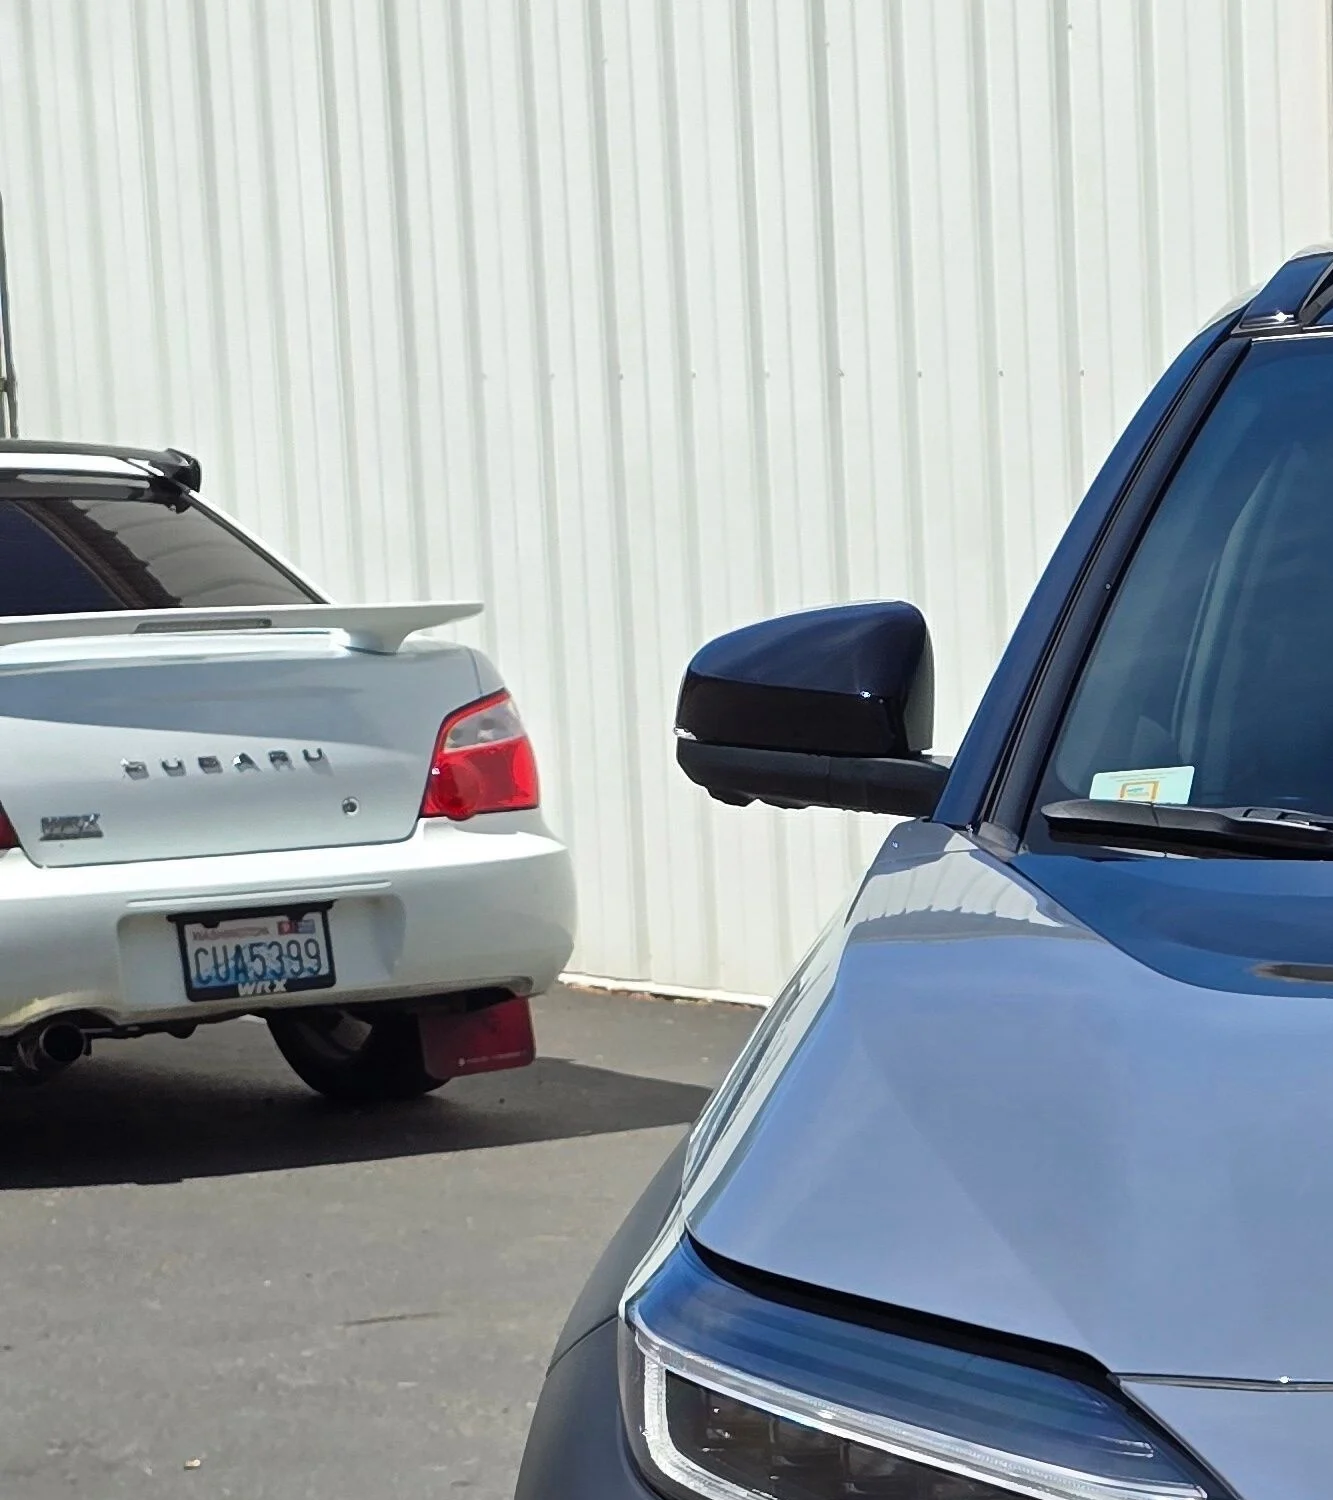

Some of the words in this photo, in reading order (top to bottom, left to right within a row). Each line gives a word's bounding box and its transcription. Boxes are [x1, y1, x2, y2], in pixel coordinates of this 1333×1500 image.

[119, 747, 324, 778] SUBARU
[194, 937, 323, 985] CUA5399
[237, 978, 289, 997] WRX
